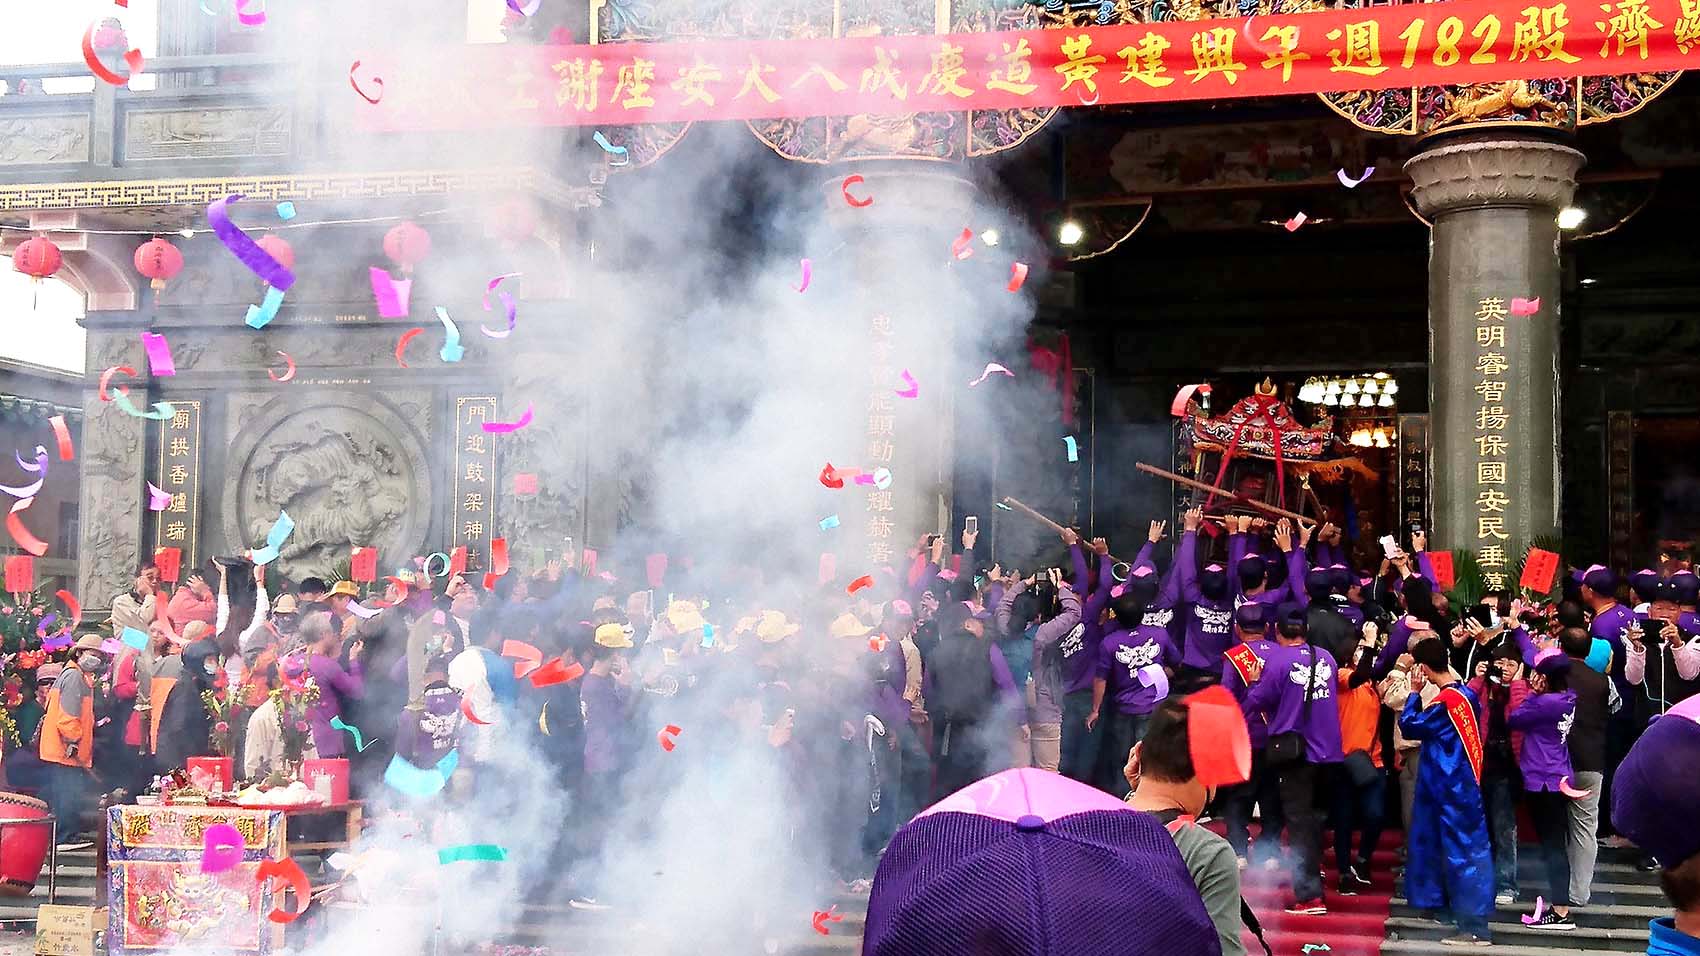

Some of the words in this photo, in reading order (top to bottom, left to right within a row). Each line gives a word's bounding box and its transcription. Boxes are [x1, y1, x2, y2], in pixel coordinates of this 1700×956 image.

[165, 408, 191, 569] 廟拱香爐瑞
